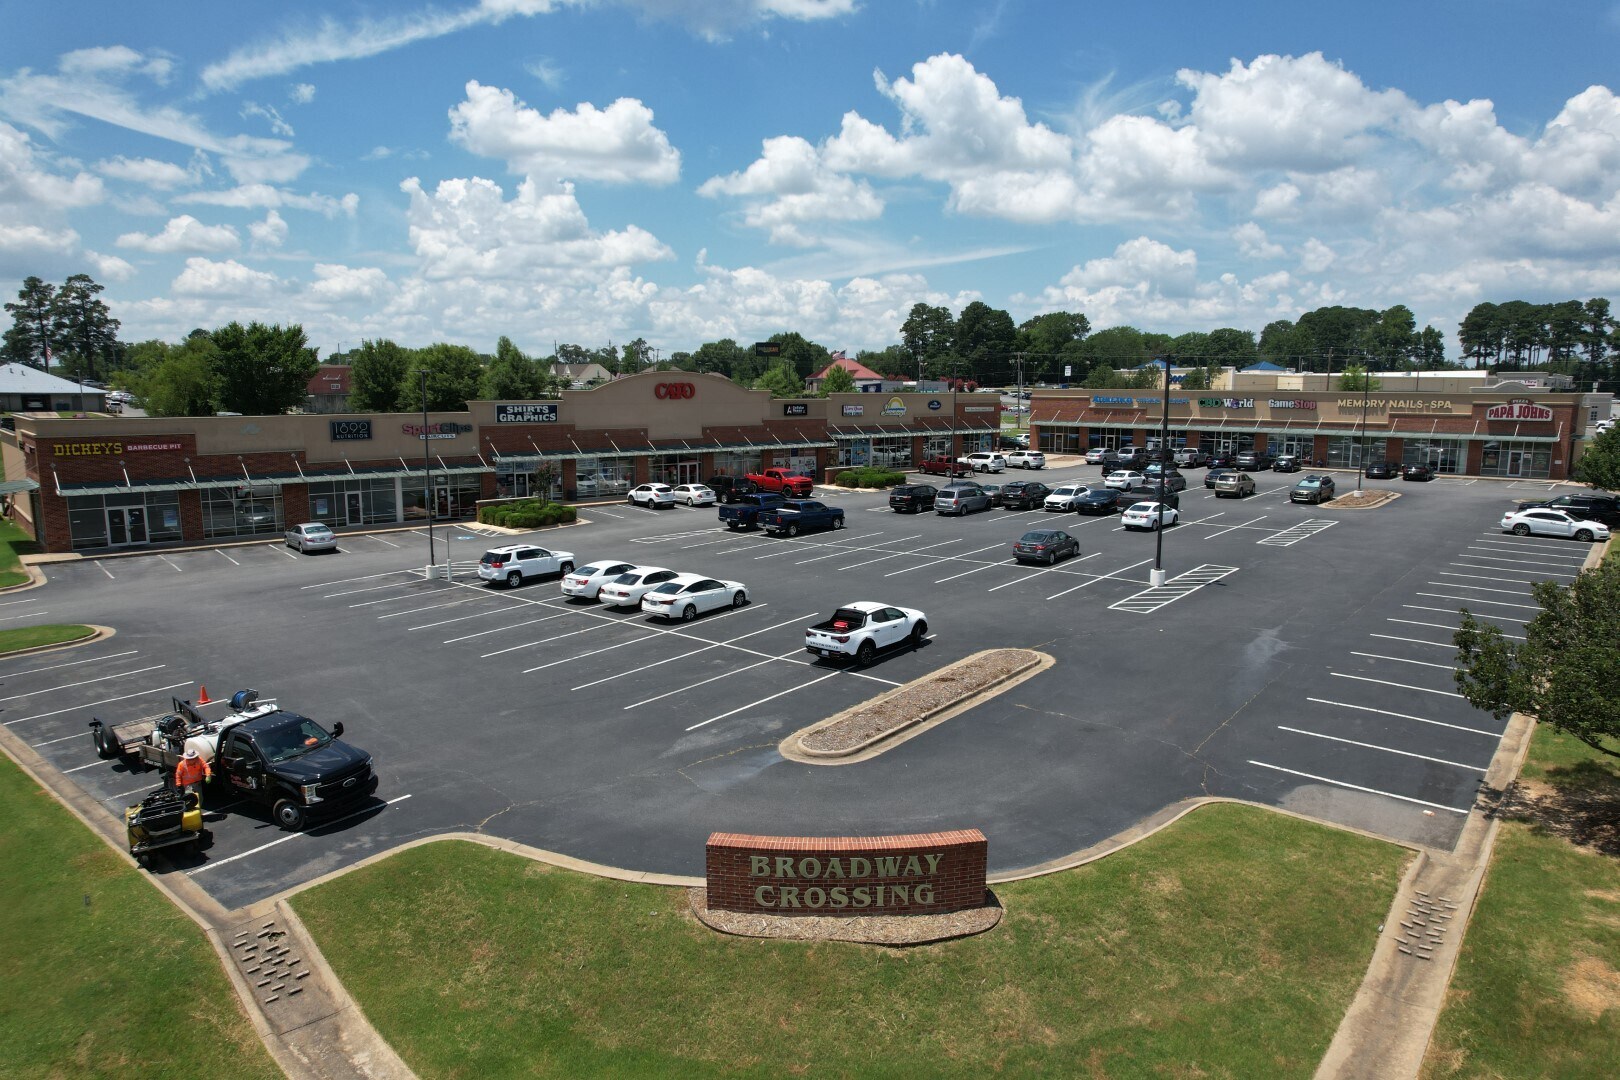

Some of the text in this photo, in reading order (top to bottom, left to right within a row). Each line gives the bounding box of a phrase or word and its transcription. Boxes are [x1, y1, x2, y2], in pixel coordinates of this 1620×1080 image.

[654, 383, 696, 400] CATO
[506, 405, 549, 414] SHIRTS
[1268, 399, 1316, 409] GameStop
[1337, 399, 1386, 408] MEMORY
[499, 413, 557, 422] GRAPHICS
[1488, 405, 1551, 419] PAPA JOHNS
[334, 422, 368, 434] 1892
[53, 442, 123, 456] DICKEYS
[749, 853, 945, 880] BROADWAY
[753, 883, 936, 908] CROSSING
